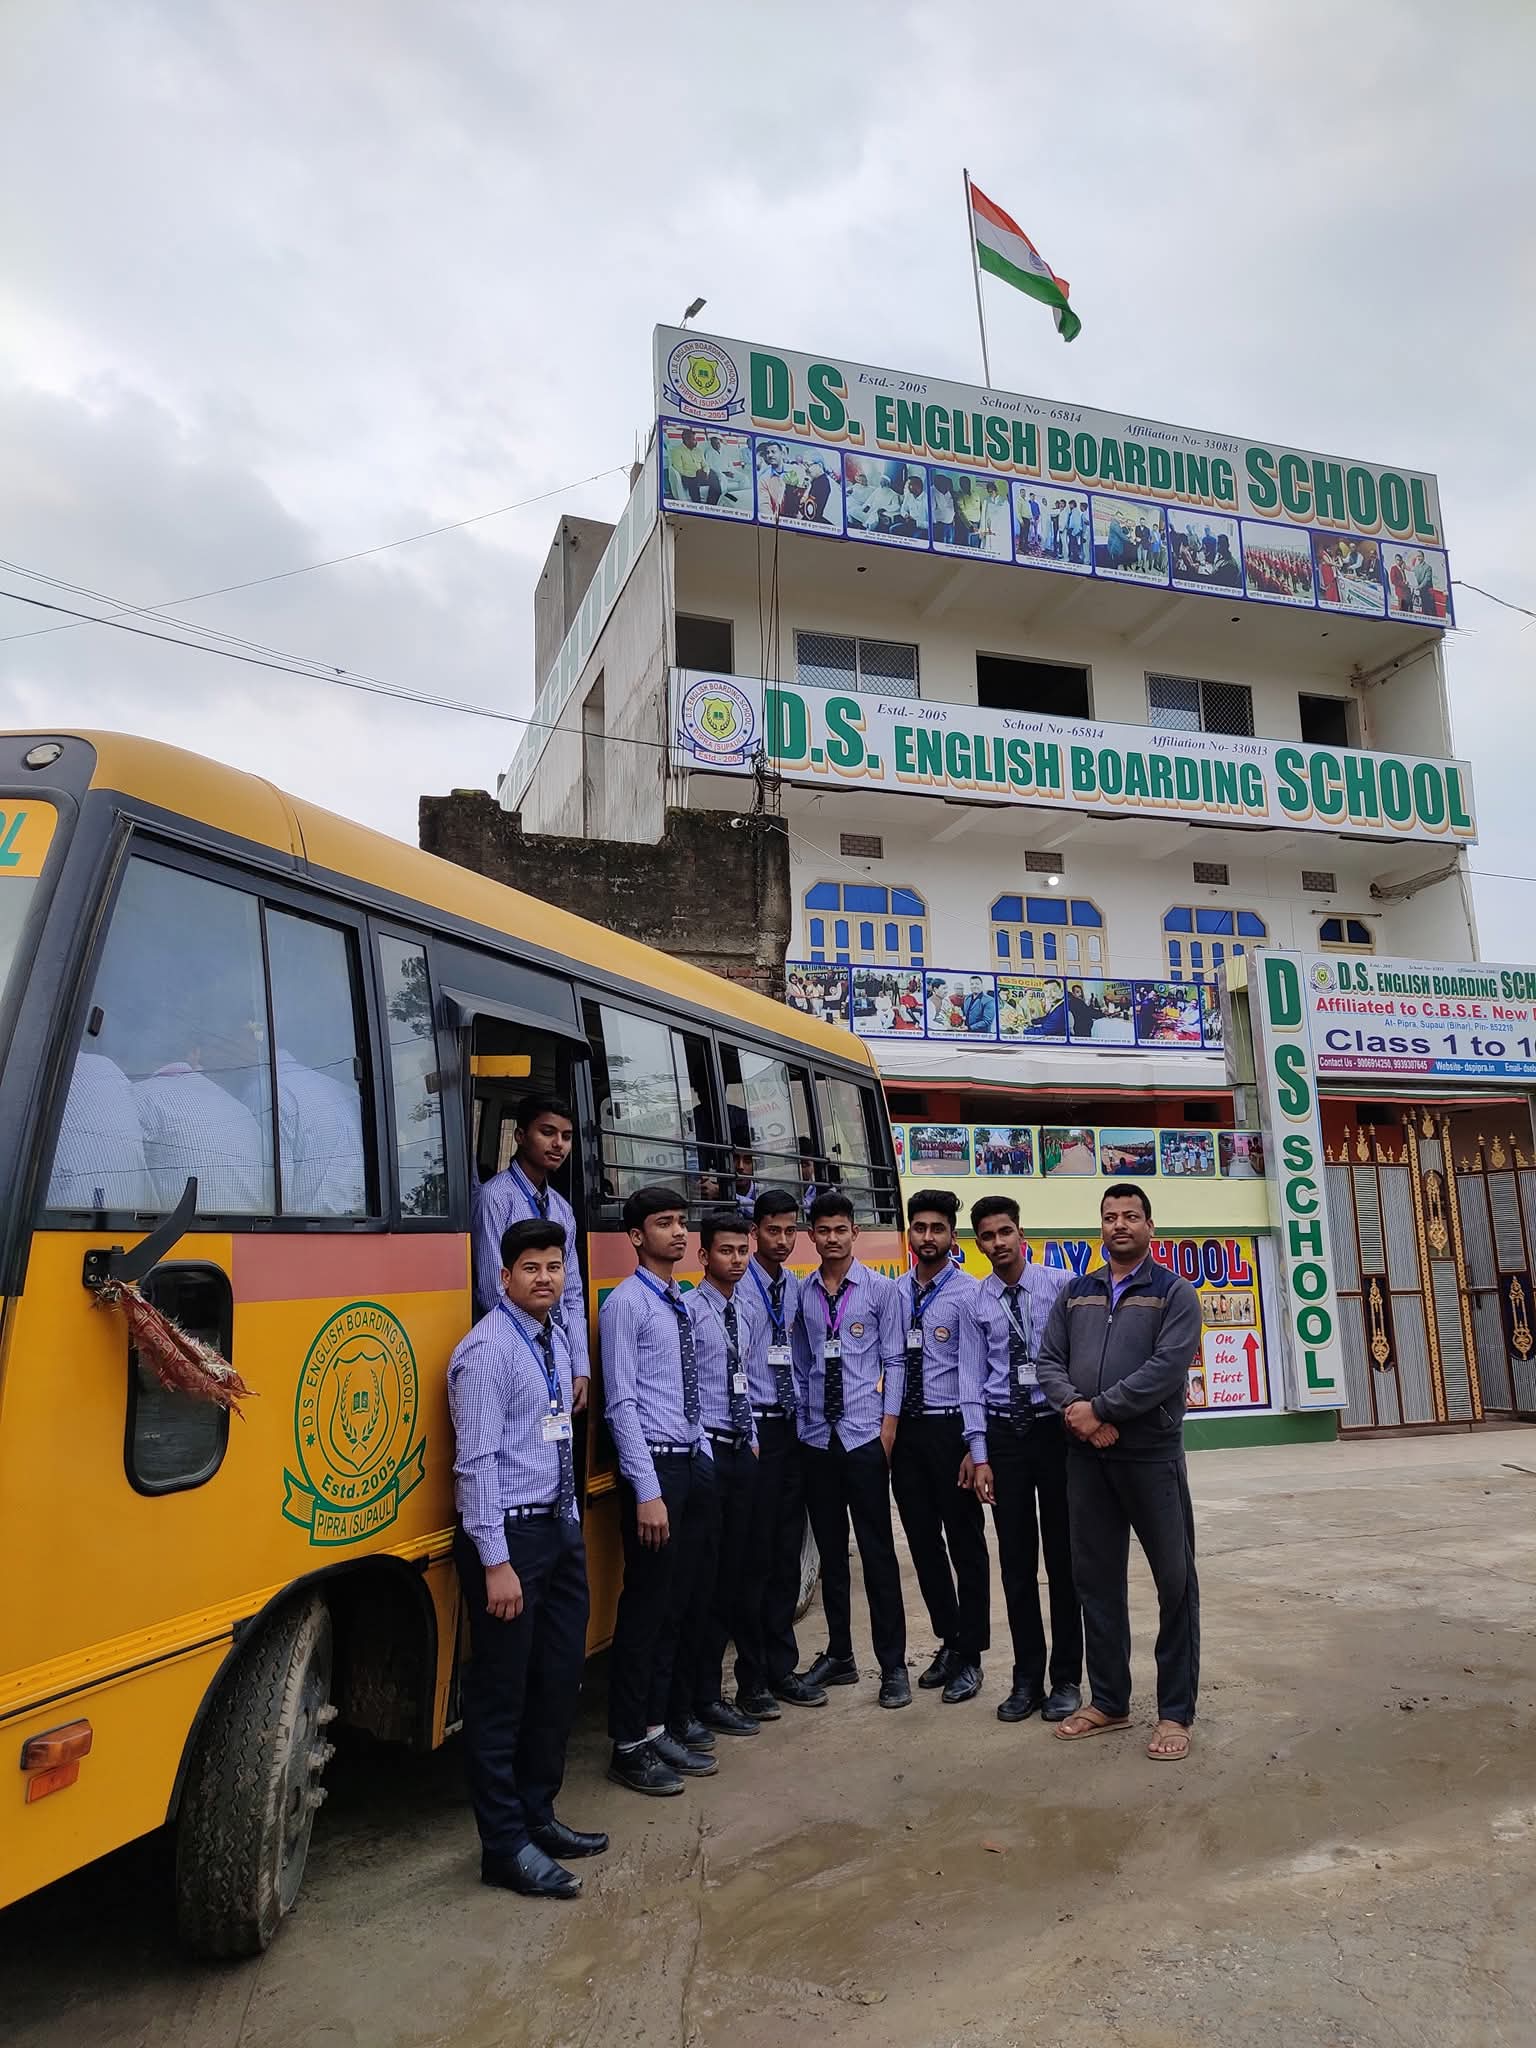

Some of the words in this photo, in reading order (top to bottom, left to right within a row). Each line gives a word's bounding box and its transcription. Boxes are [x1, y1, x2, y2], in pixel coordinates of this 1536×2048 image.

[899, 380, 928, 395] 2005
[980, 395, 1021, 412] School
[1050, 409, 1082, 423] 65814
[750, 352, 861, 436] D.S.
[875, 395, 1038, 468] ENGLISH
[1047, 427, 1235, 501] BOARDING
[1244, 447, 1435, 536] SCHOOL
[1124, 424, 1179, 442] Affiliation
[1204, 439, 1239, 454] 330813
[918, 708, 948, 722] 2005
[1002, 718, 1043, 733] School
[1148, 735, 1206, 750] Affiliation
[1209, 741, 1229, 751] No-
[1232, 743, 1268, 756] 330813
[766, 688, 880, 769] D.S.
[895, 725, 1060, 789] ENGLISH
[1070, 746, 1265, 807] BOARDING
[1274, 748, 1471, 827] SCHOOL
[1337, 962, 1373, 991] D.S.
[1377, 972, 1431, 995] ENGLISH
[1433, 975, 1497, 998] BOARDING
[1316, 997, 1394, 1014] Affiliated
[1400, 1002, 1417, 1016] to
[1422, 1002, 1487, 1018] C.B.S.E.
[1492, 1006, 1527, 1020] New
[1420, 1021, 1445, 1030] Supaul
[1325, 1029, 1431, 1054] Class
[1443, 1034, 1457, 1055] 1
[1470, 1036, 1506, 1057] to
[1517, 1037, 1536, 1057] 1
[1319, 1056, 1344, 1067] Contact
[1344, 1057, 1353, 1067] Us
[1282, 1134, 1335, 1389] SCHOOL
[1215, 1333, 1236, 1345] On
[306, 1324, 344, 1387] ENGLISH
[346, 1311, 399, 1345] BOARDING
[395, 1340, 414, 1408] SCHOOL
[1215, 1350, 1238, 1364] the
[1212, 1370, 1243, 1383] First
[1212, 1391, 1245, 1403] Floor
[316, 1513, 348, 1537] PIPRA
[349, 1495, 396, 1537] (SUPAUL)
